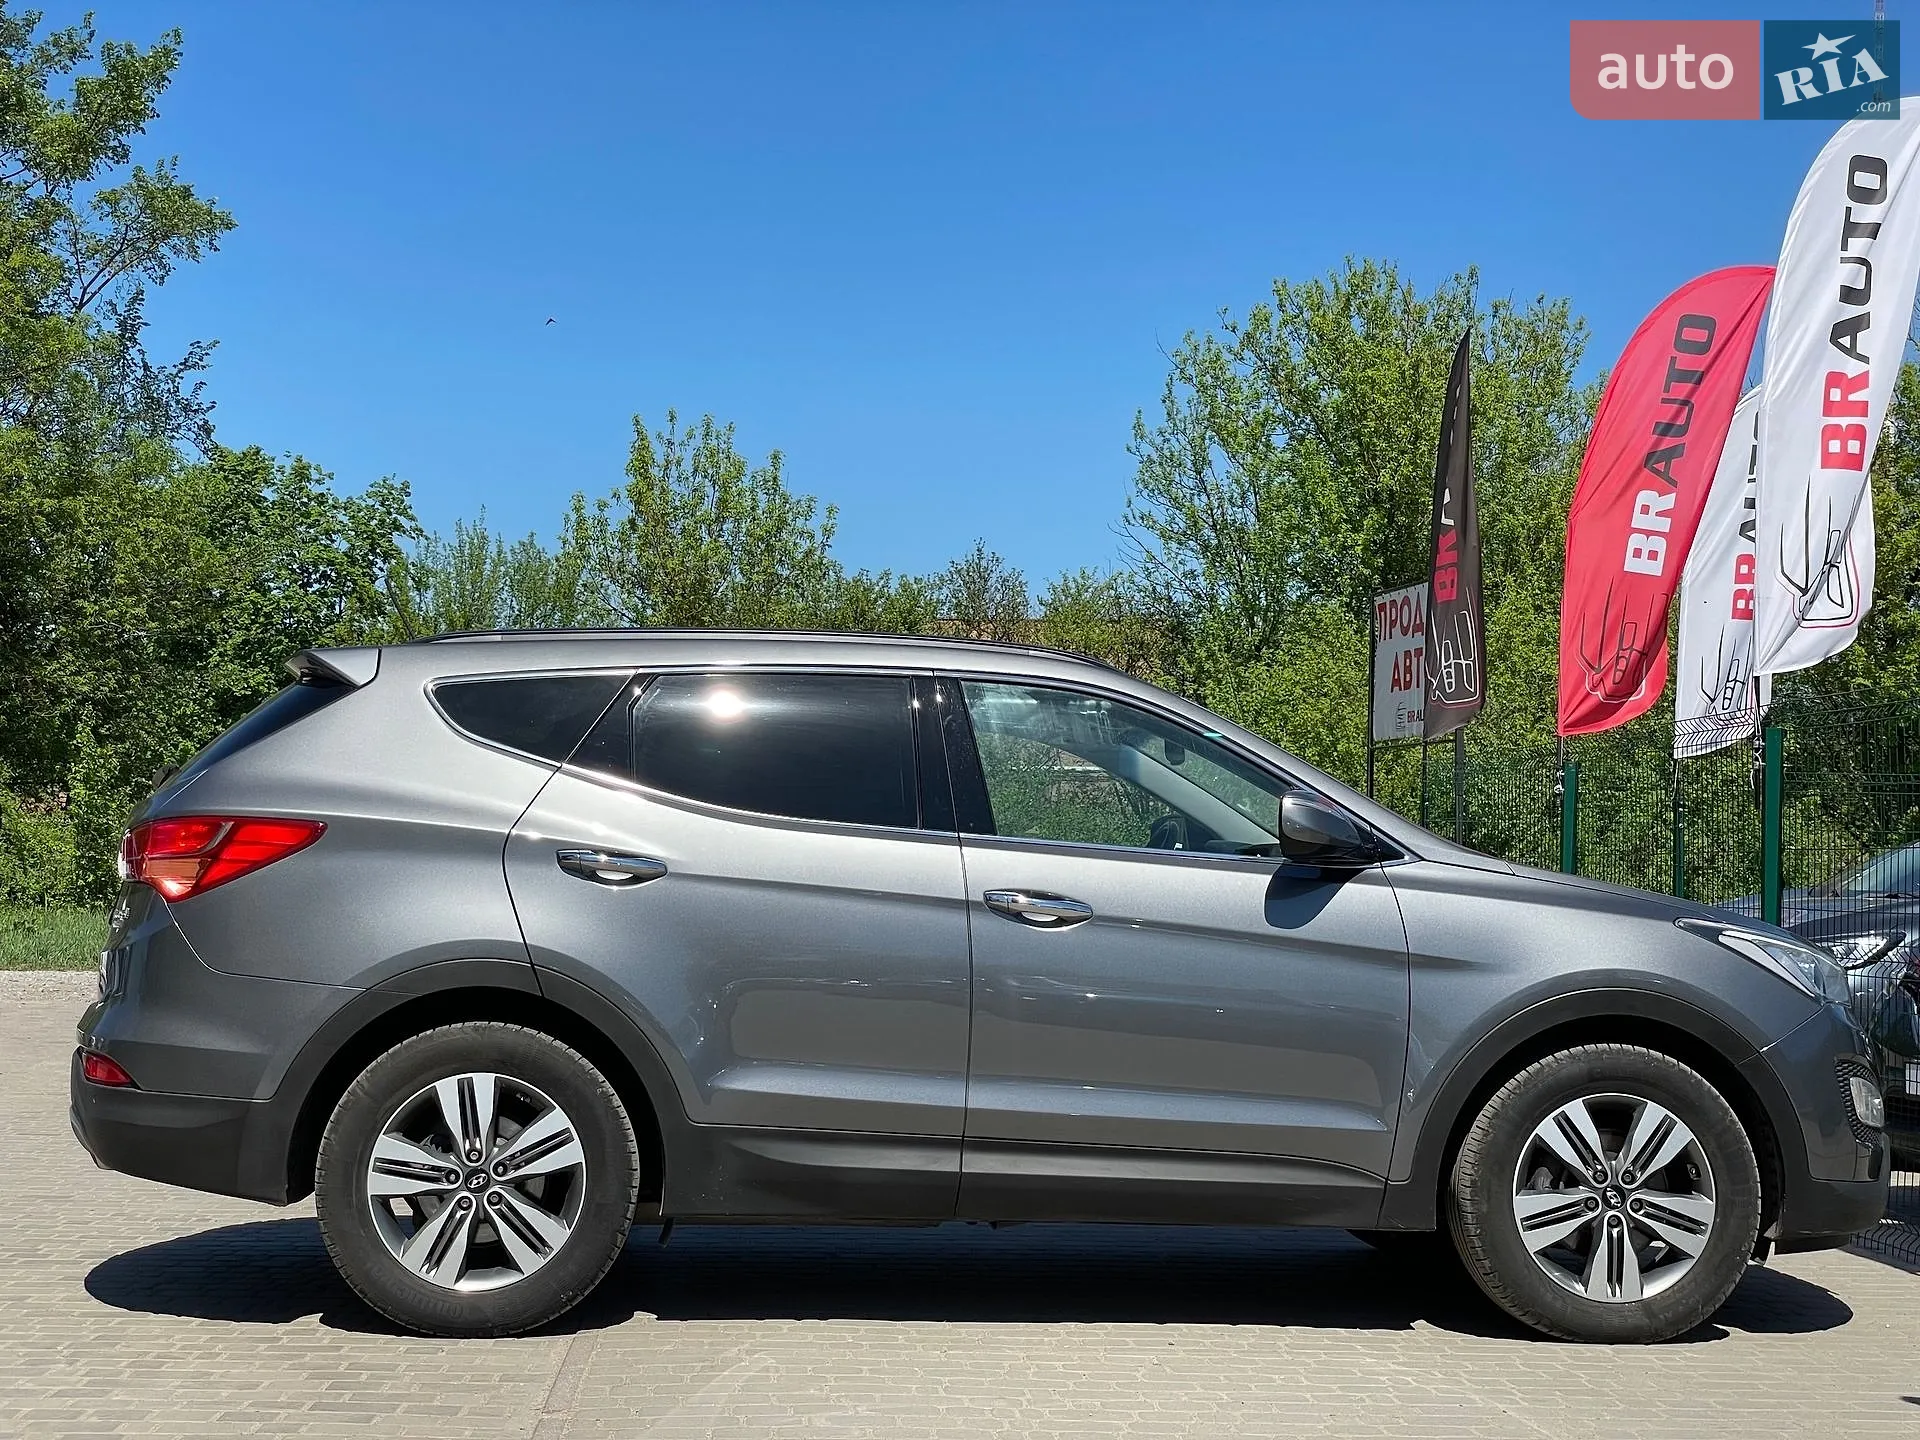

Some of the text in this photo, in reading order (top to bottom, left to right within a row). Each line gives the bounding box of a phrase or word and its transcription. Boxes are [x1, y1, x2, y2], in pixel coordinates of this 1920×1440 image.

[1821, 154, 1889, 472] BRAUTO
[1624, 313, 1717, 577] BRAUTO
[1377, 592, 1424, 642] ПРОД
[1390, 647, 1424, 693] АВТ
